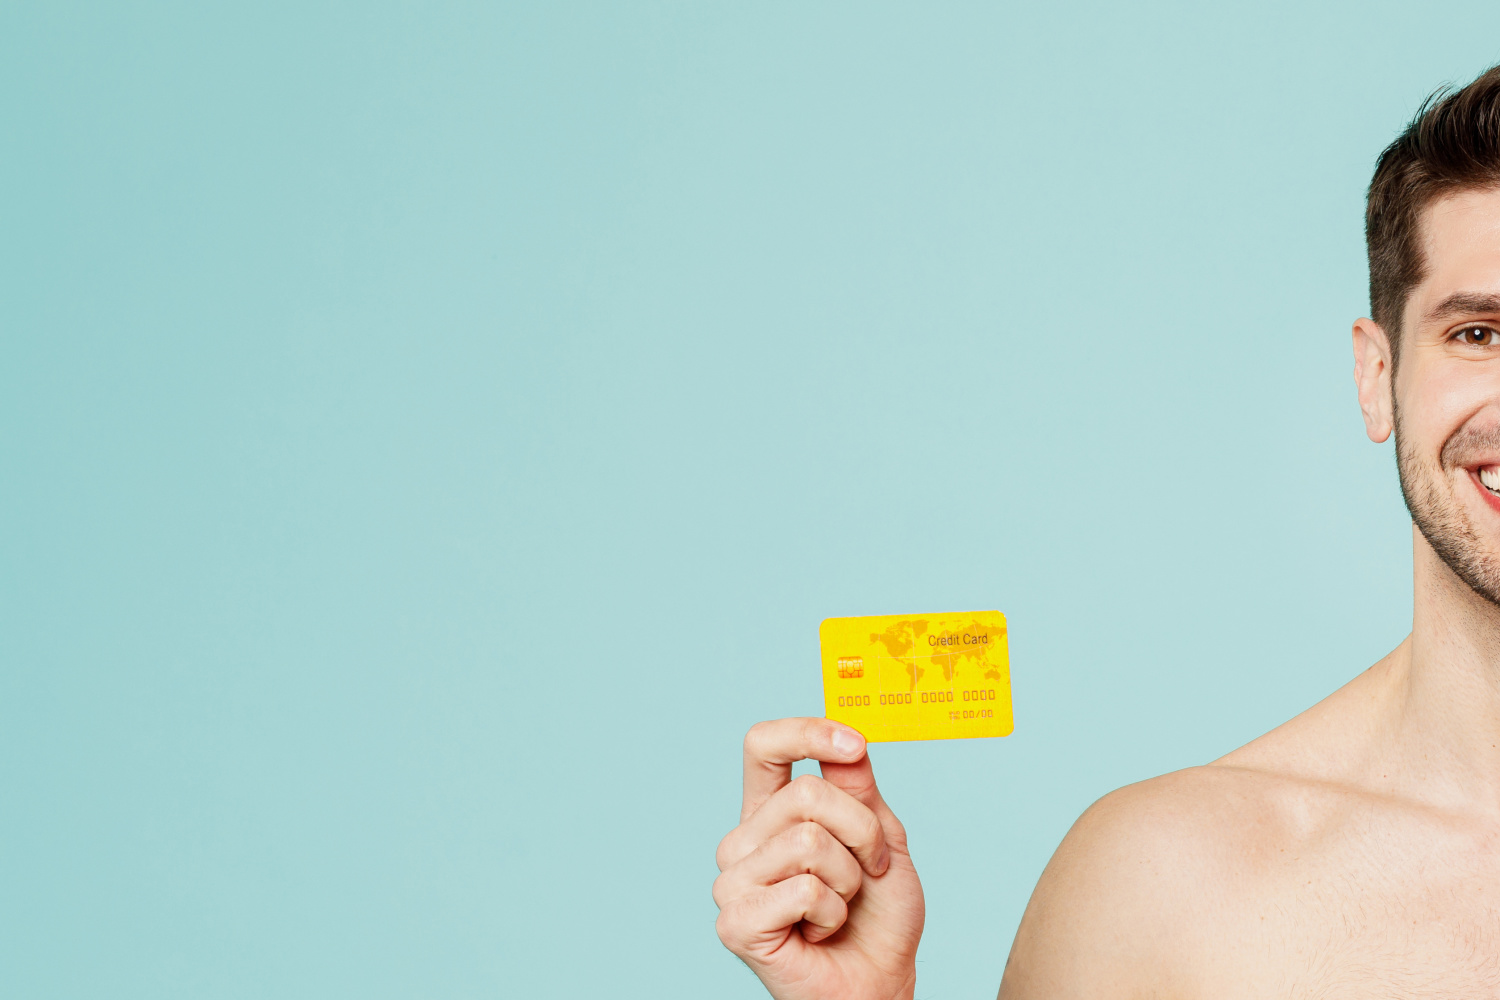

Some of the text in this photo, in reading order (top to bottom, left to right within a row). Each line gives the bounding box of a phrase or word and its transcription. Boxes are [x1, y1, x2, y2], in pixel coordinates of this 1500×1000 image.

[928, 633, 988, 646] Credit Card
[838, 689, 996, 707] 0000 0000 0000 0000
